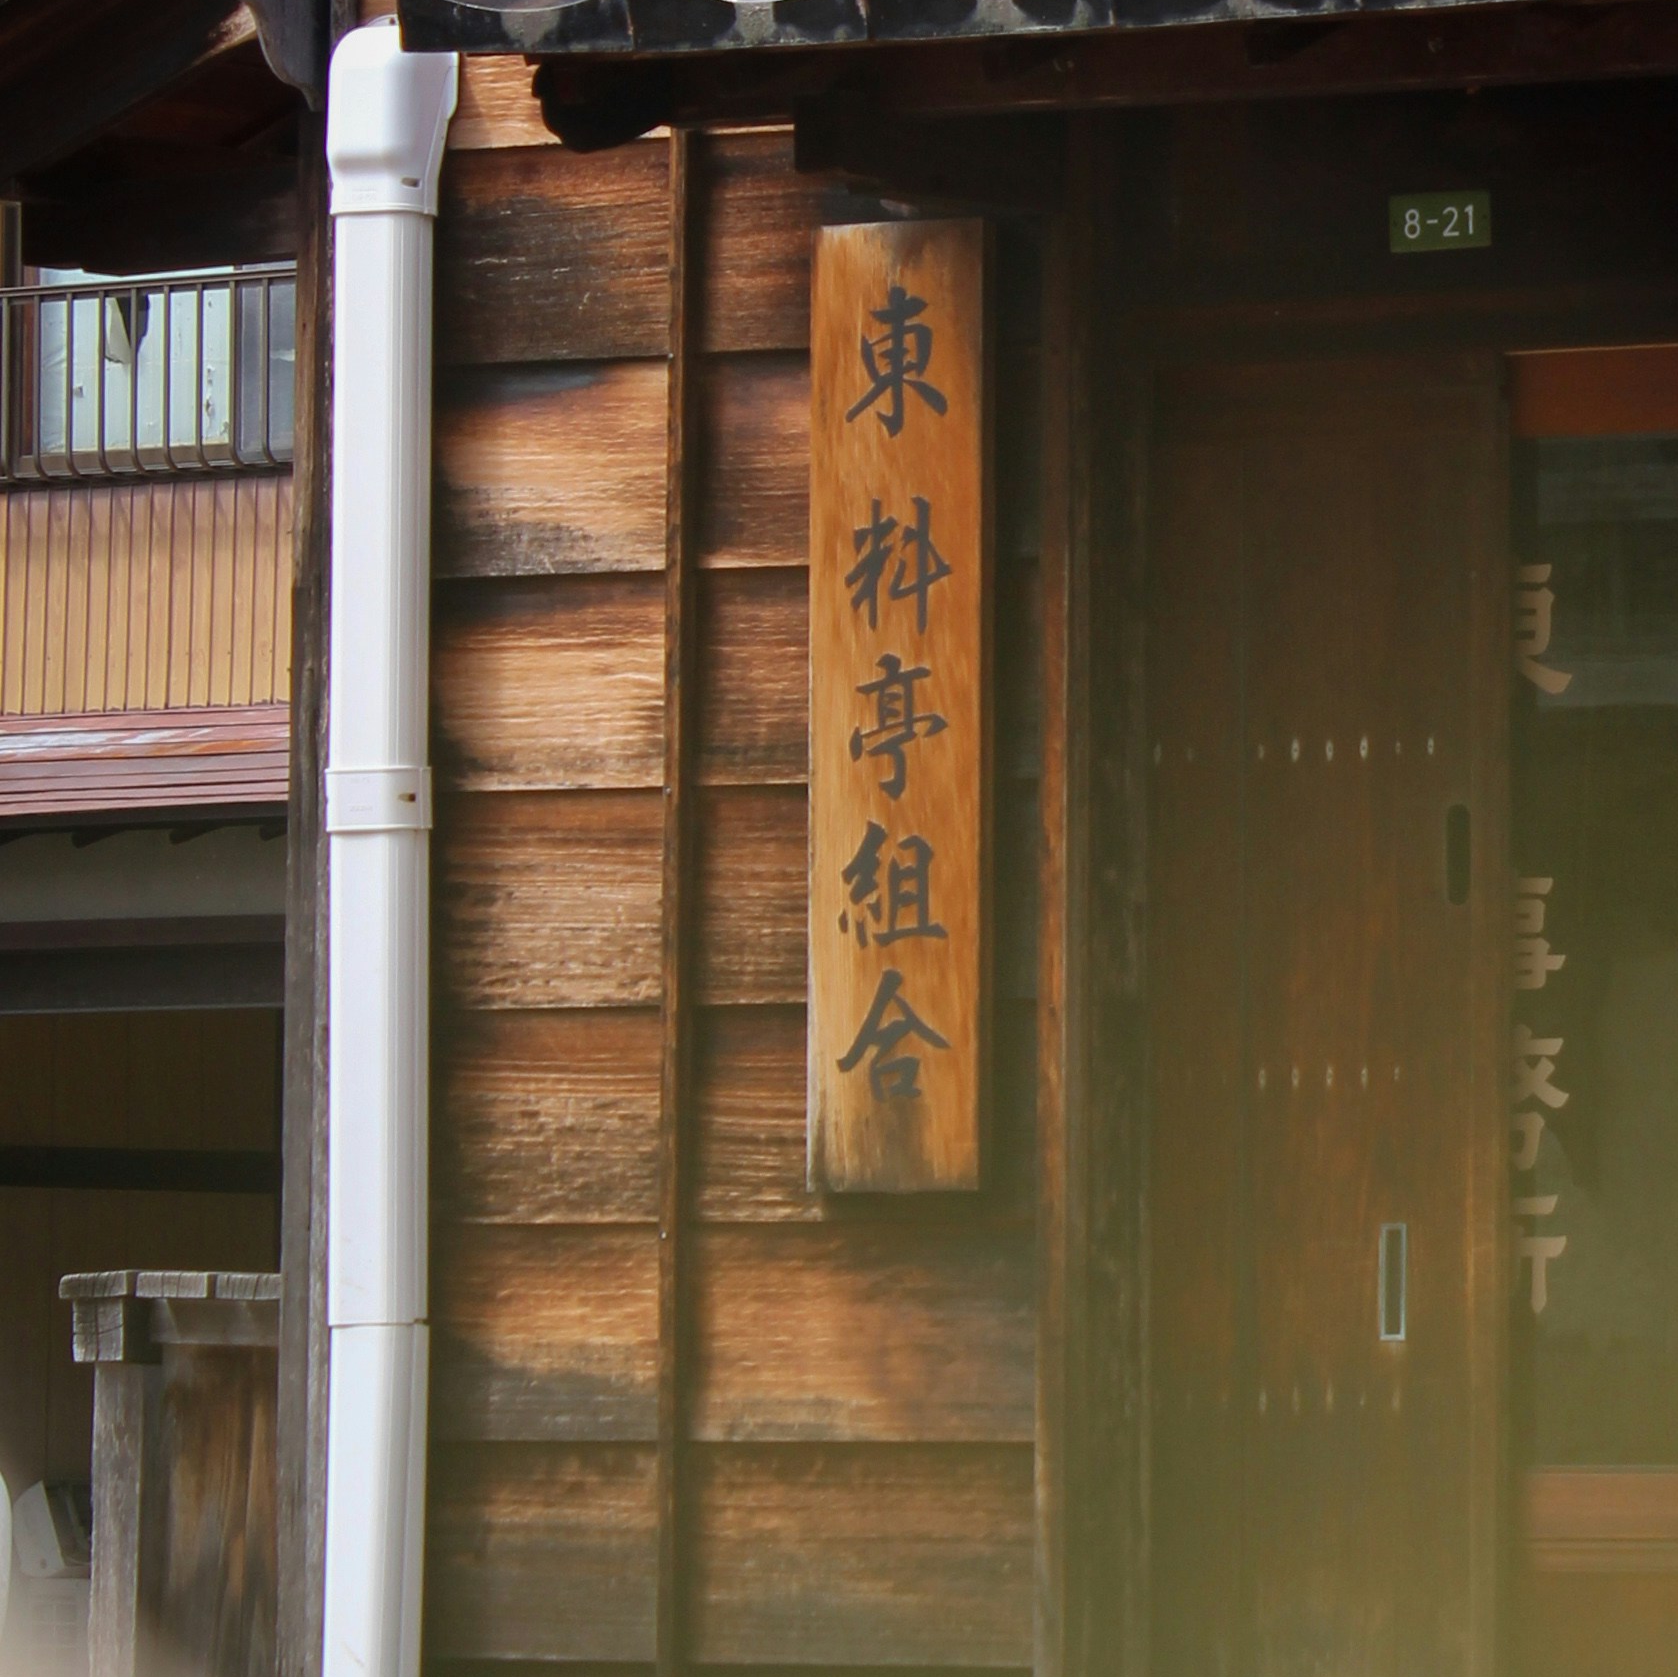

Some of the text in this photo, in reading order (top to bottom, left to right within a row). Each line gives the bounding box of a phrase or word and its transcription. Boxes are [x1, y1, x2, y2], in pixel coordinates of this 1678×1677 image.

[1403, 204, 1475, 240] 8-21
[836, 285, 952, 1105] 東料亭組合
